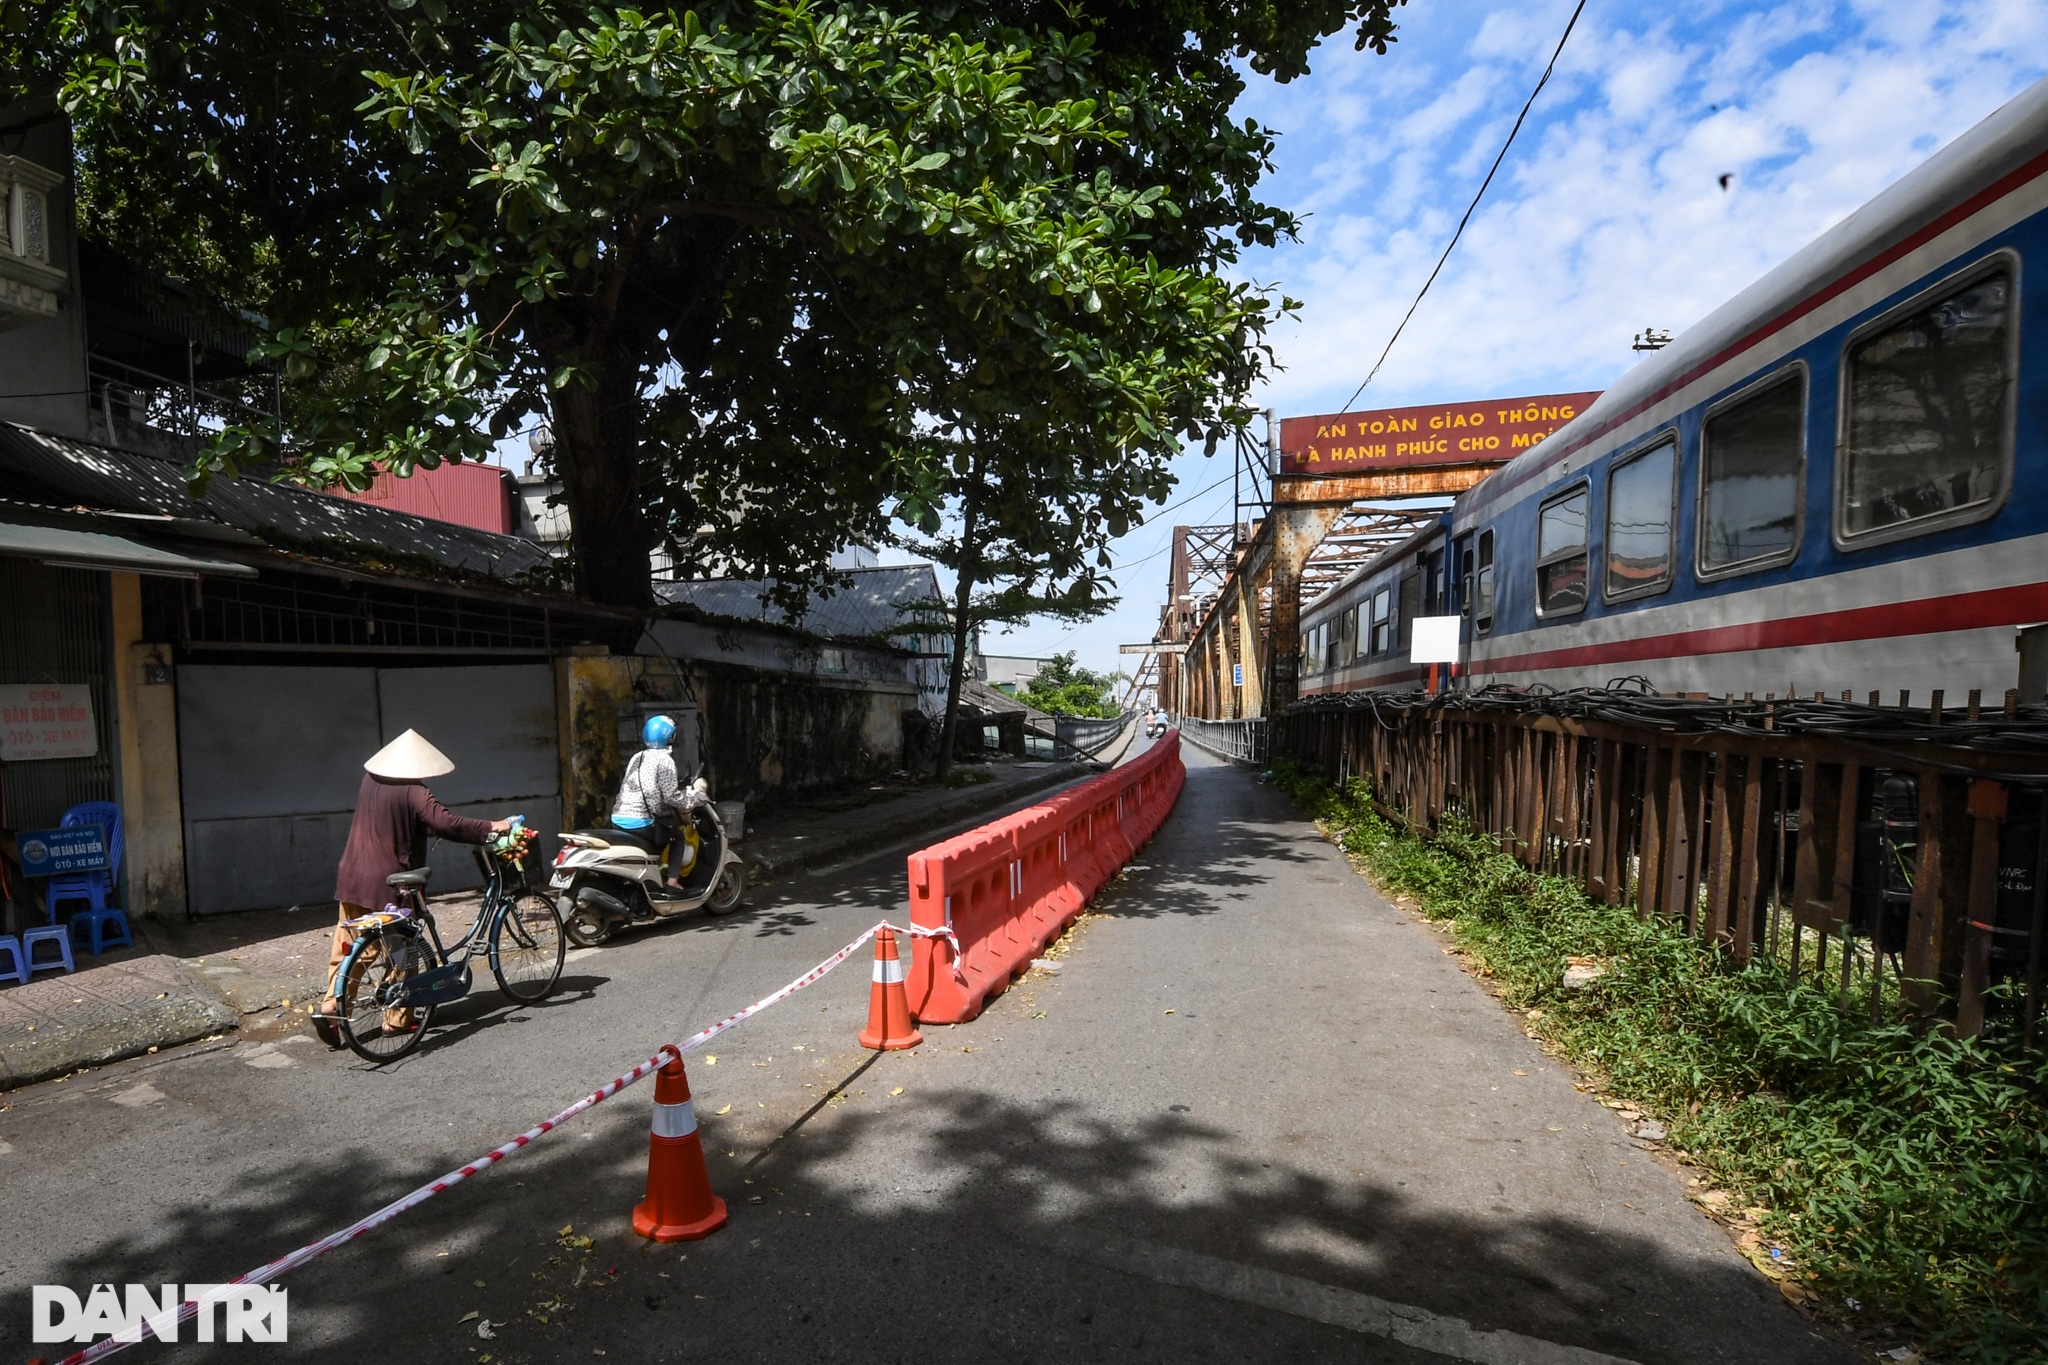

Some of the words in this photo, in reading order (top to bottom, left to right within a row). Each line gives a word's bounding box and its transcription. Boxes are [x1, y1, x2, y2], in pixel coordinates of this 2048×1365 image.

[1316, 424, 1346, 438] AN
[1358, 415, 1417, 436] TOÀN
[1497, 402, 1575, 425] THÔNG
[1296, 445, 1321, 464] LÀ
[1331, 444, 1386, 464] HẠNH
[1396, 433, 1448, 456] PHÚC
[1459, 436, 1500, 451] CHO
[43, 730, 58, 743] XE
[76, 859, 87, 867] XE
